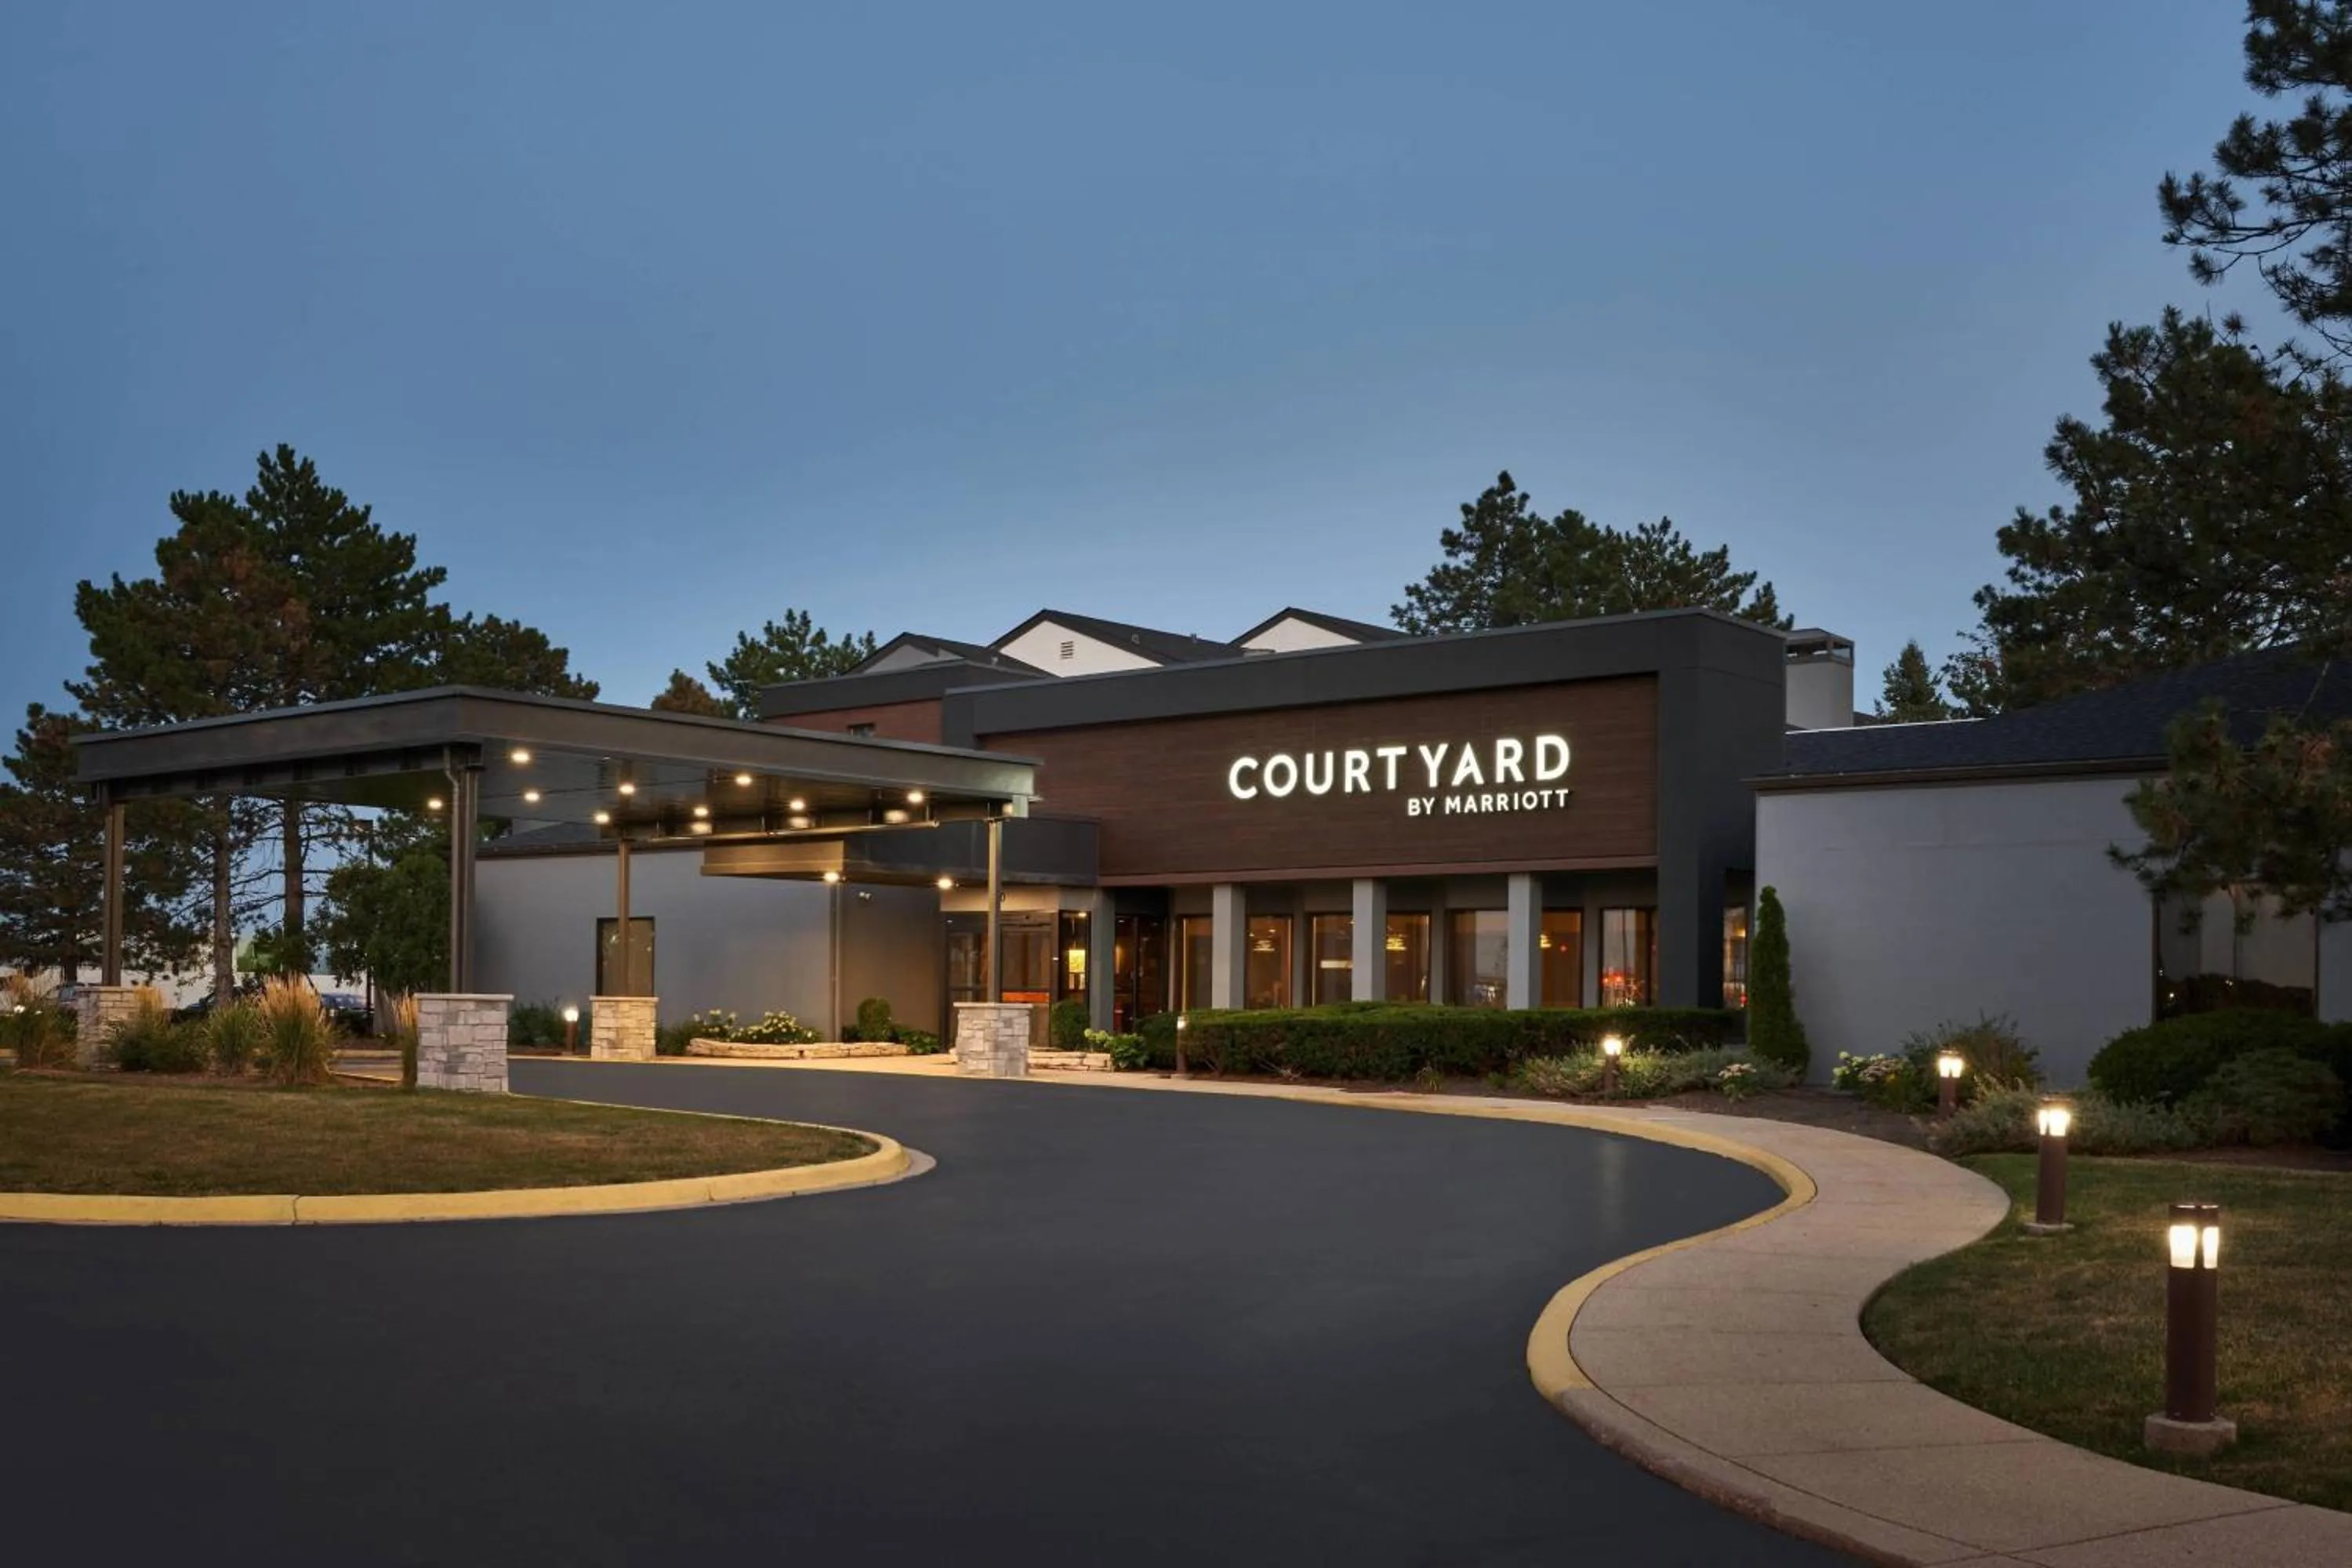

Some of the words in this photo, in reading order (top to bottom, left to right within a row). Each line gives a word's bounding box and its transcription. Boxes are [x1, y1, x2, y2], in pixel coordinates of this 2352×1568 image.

[1228, 735, 1570, 800] COURTYARD
[1407, 797, 1436, 816] BY
[1444, 789, 1569, 815] MARRIOTT
